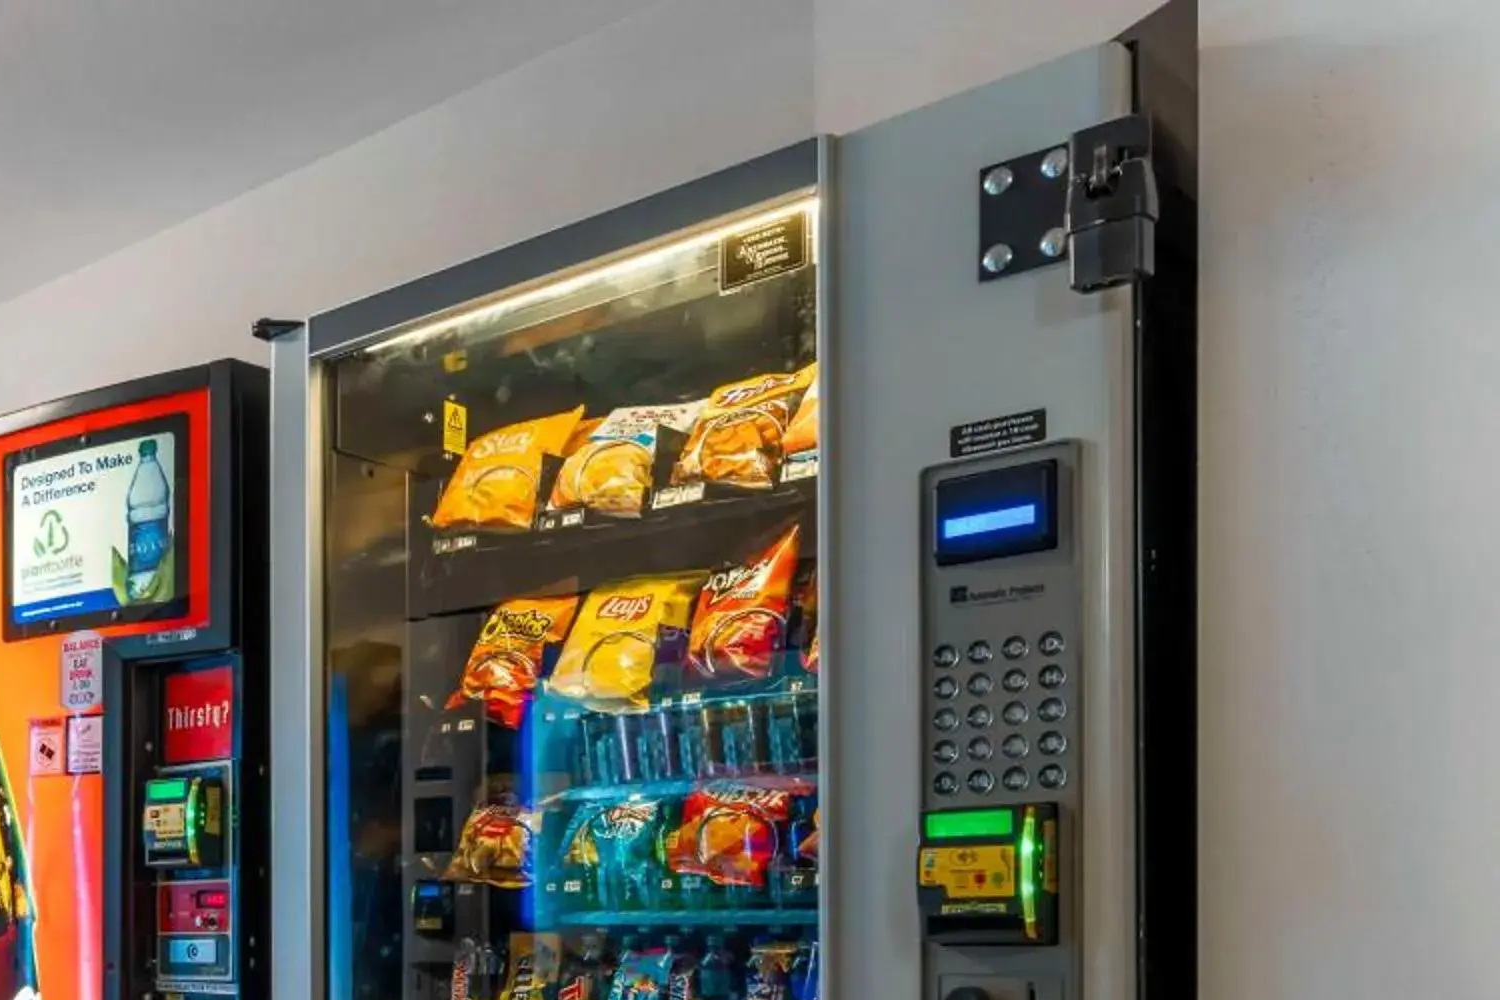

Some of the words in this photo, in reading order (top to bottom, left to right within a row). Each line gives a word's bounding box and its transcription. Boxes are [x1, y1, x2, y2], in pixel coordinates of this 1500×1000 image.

[20, 464, 75, 491] Designed
[77, 461, 93, 475] To
[95, 453, 133, 471] Make
[21, 495, 31, 507] A
[33, 480, 96, 505] Difference
[599, 596, 651, 621] Lay's
[168, 700, 229, 731] Thirsty?
